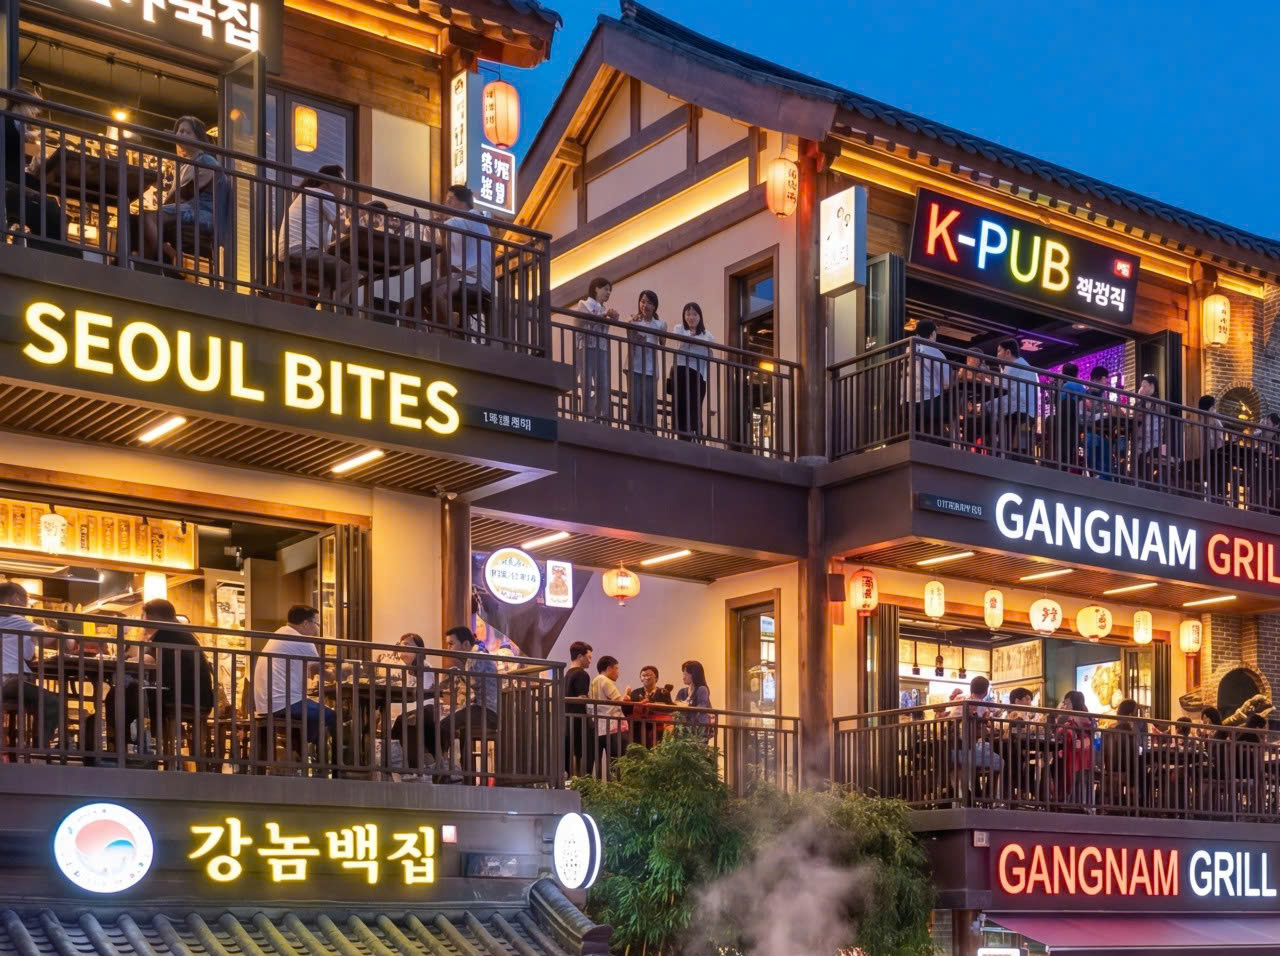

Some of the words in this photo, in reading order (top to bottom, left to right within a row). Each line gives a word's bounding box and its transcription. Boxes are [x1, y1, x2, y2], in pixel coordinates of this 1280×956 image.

[926, 203, 1070, 291] K-PUB
[22, 302, 265, 402] SEOUL
[284, 351, 460, 435] BITES
[995, 492, 1197, 570] GANGNAM
[188, 817, 435, 885] 강놈백집
[999, 843, 1179, 895] GANGNAM
[1189, 850, 1277, 897] GRILL
